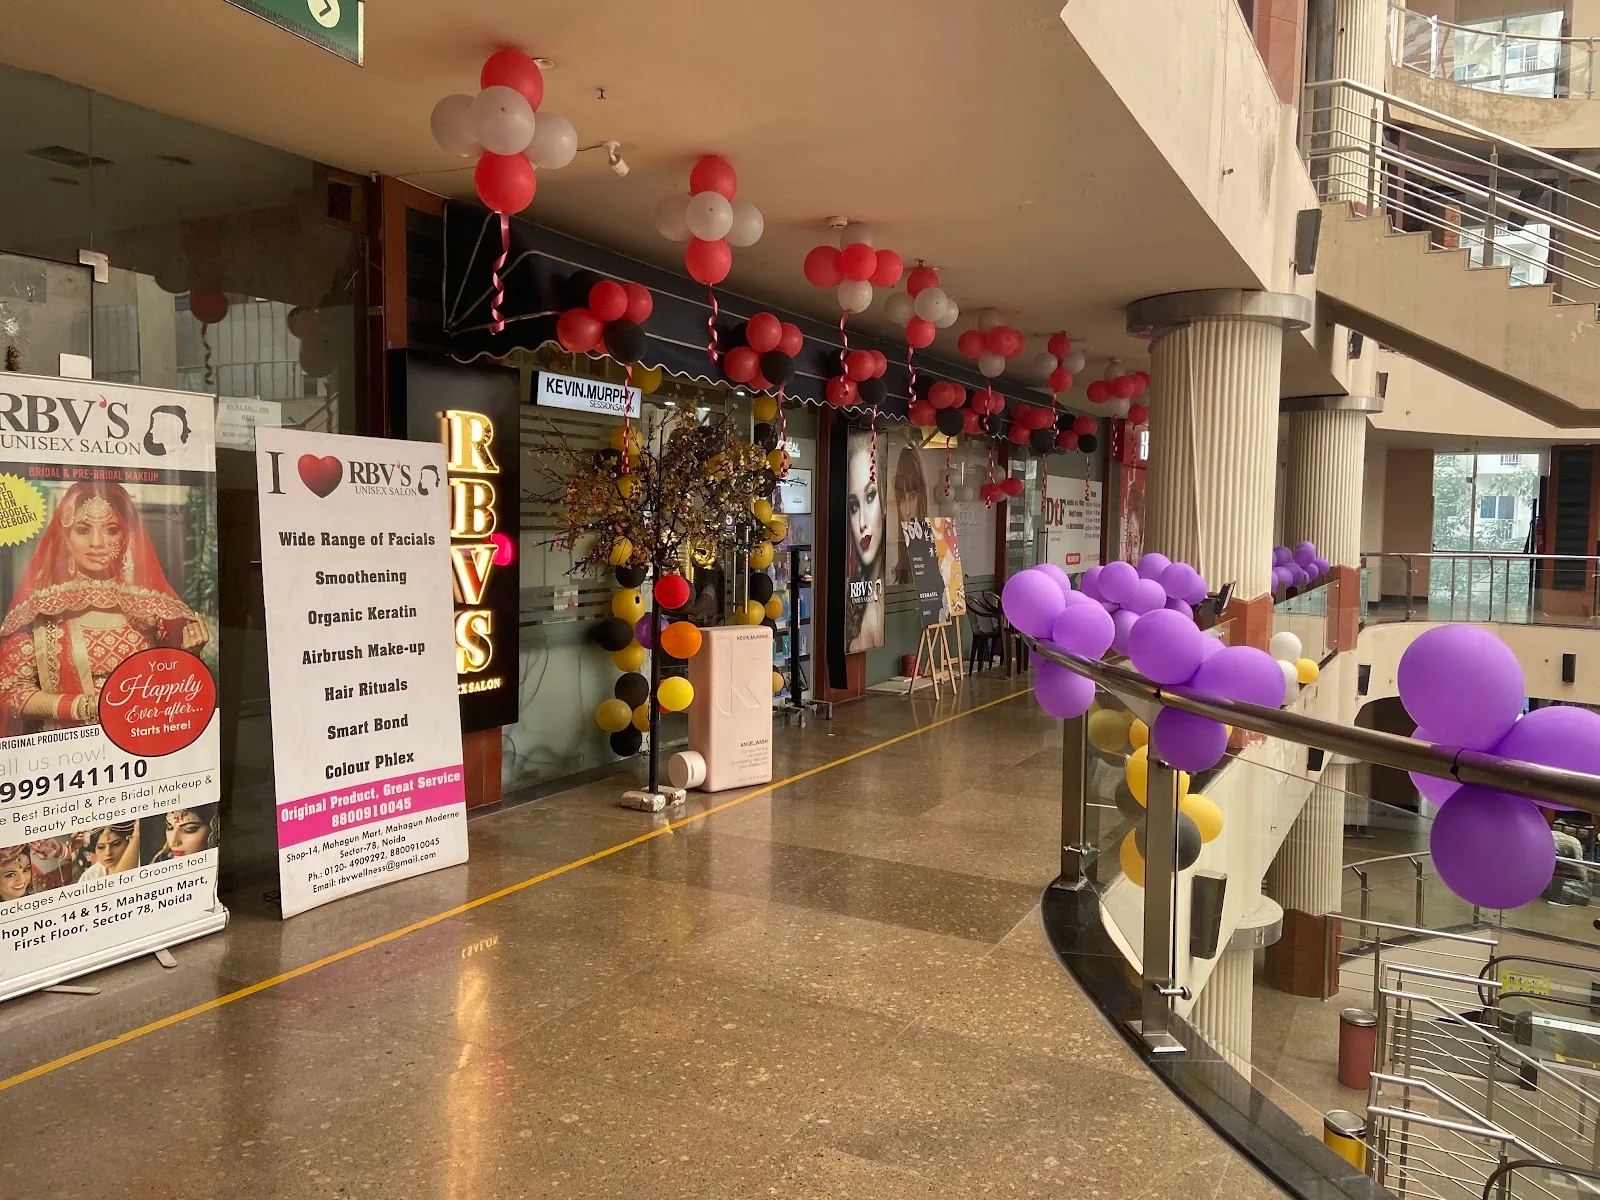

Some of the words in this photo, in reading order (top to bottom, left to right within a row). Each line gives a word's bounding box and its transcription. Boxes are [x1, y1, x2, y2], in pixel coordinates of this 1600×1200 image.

[1, 435, 74, 452] UNISEX
[80, 439, 141, 455] SALON
[28, 466, 60, 478] BRIDAL
[63, 468, 70, 478] &
[72, 469, 123, 481] PRE-BRIDAL
[125, 471, 159, 482] MAKEUP
[265, 450, 287, 495] I
[347, 460, 412, 487] RBV'S
[354, 485, 388, 496] UNISEX
[389, 486, 417, 496] SALON
[279, 531, 316, 546] Wide
[320, 532, 366, 549] Range
[370, 532, 384, 546] of
[388, 532, 436, 546] Facials
[315, 569, 408, 585] Smoothening
[307, 608, 363, 627] Organic
[367, 605, 418, 621] Keratin
[148, 660, 178, 672] Your
[302, 645, 363, 665] Airbrush
[367, 641, 426, 659] Make-up
[105, 673, 204, 707] Happily
[324, 685, 354, 702] Hair
[359, 679, 408, 697] Rituals
[468, 677, 502, 694] SALON
[37, 730, 79, 746] PRODUCTS
[80, 728, 100, 739] USED
[130, 725, 161, 738] Starts
[163, 720, 191, 732] here!
[327, 721, 369, 740] Smart
[374, 713, 409, 732] Bond
[0, 757, 18, 776] all
[28, 757, 49, 772] us
[58, 745, 107, 767] now!
[325, 760, 370, 780] Colour
[375, 752, 415, 769] Phlex
[0, 759, 148, 803] 999141110
[12, 811, 38, 824] Best
[43, 801, 80, 817] Bridal
[84, 798, 93, 808] &
[98, 795, 116, 806] Pre
[121, 785, 154, 801] Bridal
[158, 777, 202, 795] Makeup
[204, 775, 213, 784] &
[281, 798, 327, 823] Original
[330, 787, 380, 809] Product,
[383, 779, 414, 797] Great
[417, 771, 461, 789] Service
[24, 816, 66, 836] Beauty
[71, 807, 126, 826] Packages
[130, 803, 149, 814] are
[153, 794, 181, 808] here!
[331, 797, 412, 828] 8800910045
[286, 846, 320, 863] Shop-14,
[322, 833, 360, 852] Mahagun
[362, 827, 384, 842] Mart,
[385, 818, 423, 835] Mahagun
[425, 811, 460, 824] Moderne
[339, 842, 380, 859] Sector-78,
[382, 834, 406, 848] Noida
[324, 864, 348, 877] 0120-
[349, 850, 388, 868] 4909292,
[390, 837, 440, 857] 8800910045
[1, 895, 54, 917] ackages
[58, 879, 115, 902] Available
[119, 873, 135, 885] for
[139, 861, 184, 879] Grooms
[187, 854, 208, 868] too!
[312, 880, 337, 894] Email:
[338, 850, 437, 885] rbvwellness@gmail.com
[1, 924, 29, 940] hop
[33, 917, 57, 931] No.
[62, 910, 77, 923] 14
[80, 907, 90, 918] &
[94, 901, 113, 914] 15,
[116, 884, 173, 908] Mahagun
[176, 875, 209, 892] Mart,
[14, 936, 46, 951] First
[50, 924, 88, 941] Floor,
[92, 911, 133, 928] Sector
[136, 904, 154, 917] 78,
[158, 892, 193, 909] Noida
